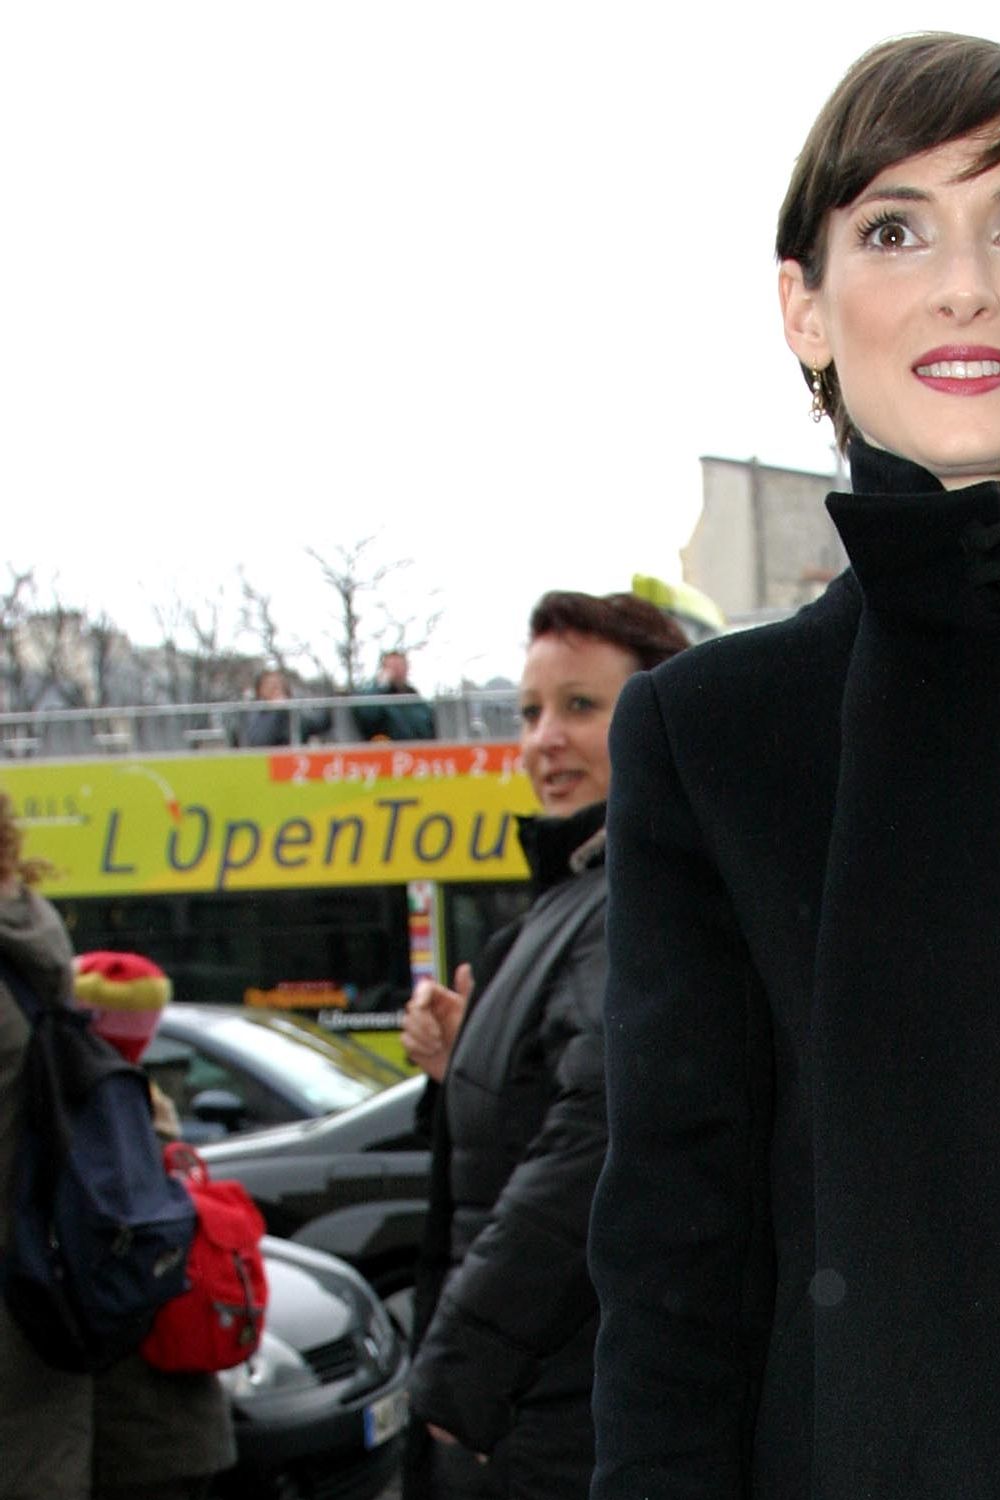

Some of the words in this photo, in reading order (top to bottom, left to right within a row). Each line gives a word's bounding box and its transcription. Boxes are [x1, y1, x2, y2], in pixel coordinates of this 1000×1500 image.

[292, 755, 311, 786] 2
[322, 752, 381, 790] day
[391, 749, 458, 782] Pass
[468, 746, 489, 778] 2
